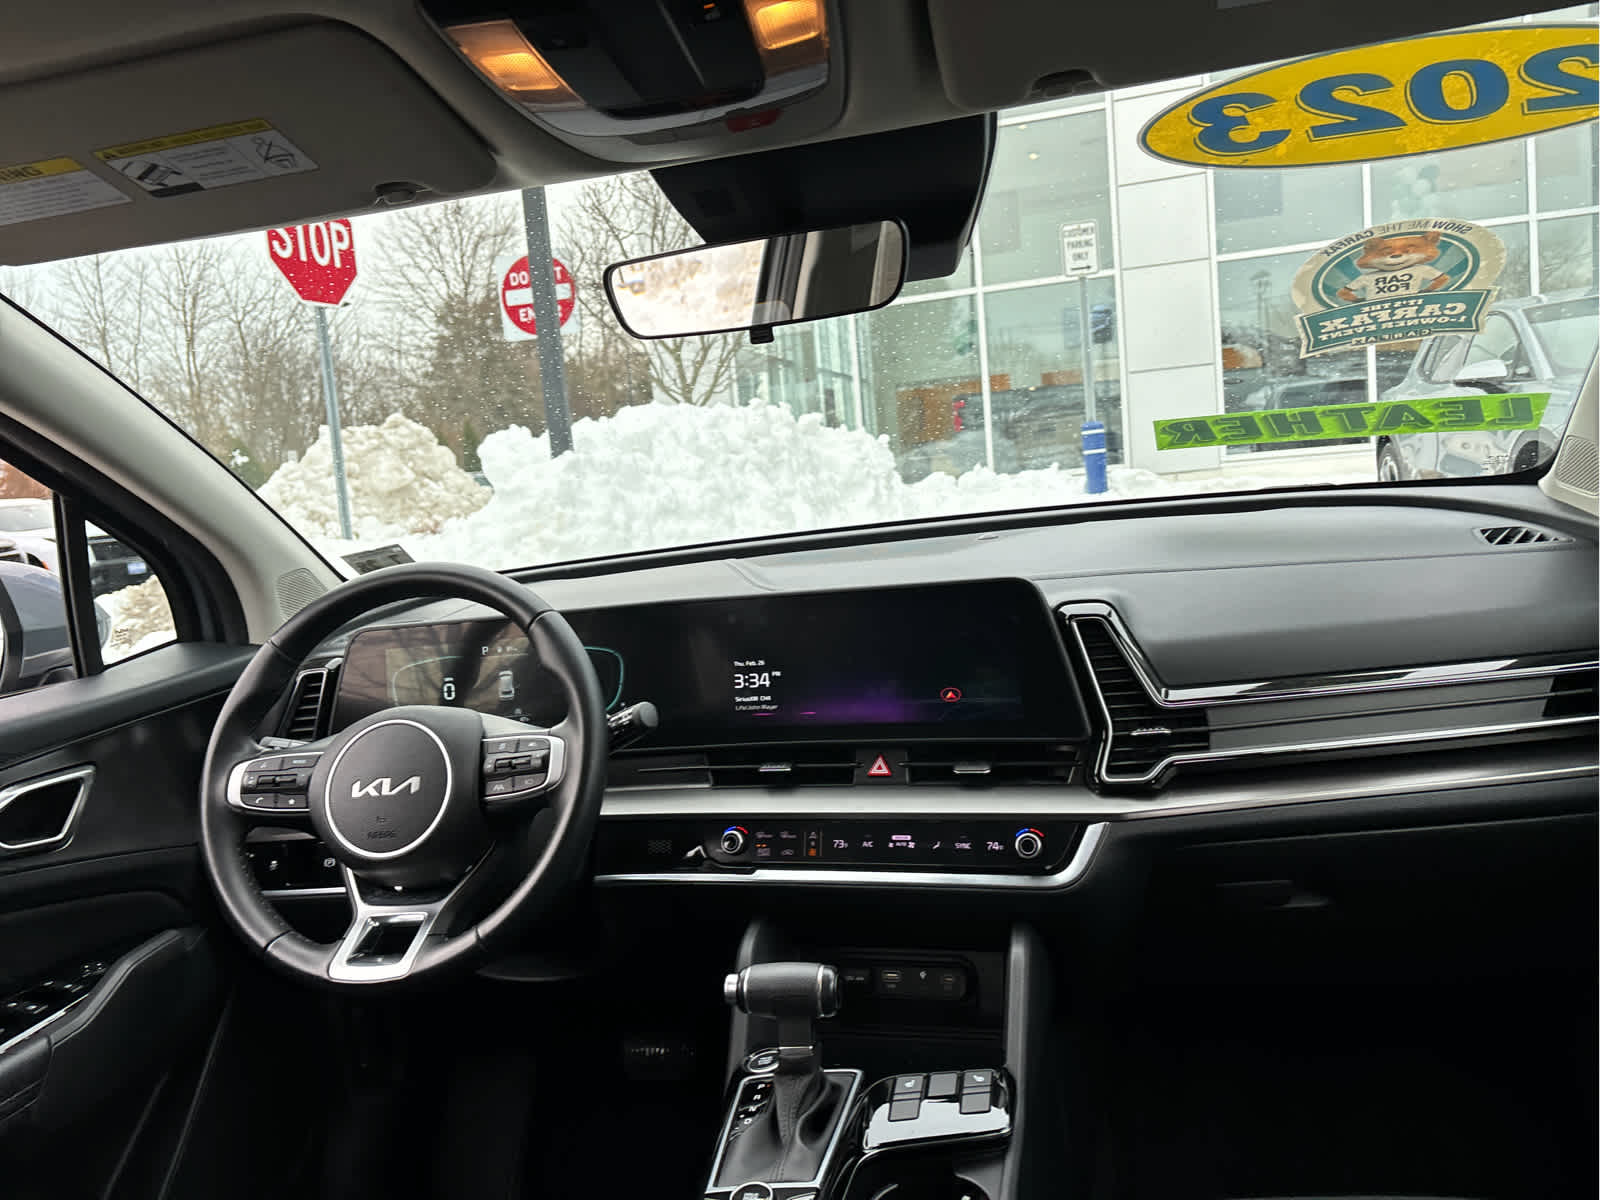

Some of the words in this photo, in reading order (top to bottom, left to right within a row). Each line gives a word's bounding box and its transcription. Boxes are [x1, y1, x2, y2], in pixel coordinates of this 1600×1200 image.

[272, 221, 350, 268] STOP
[509, 271, 529, 287] DO
[481, 646, 489, 656] P
[734, 673, 770, 688] 3:34
[443, 682, 456, 701] 0
[351, 775, 421, 798] KIA
